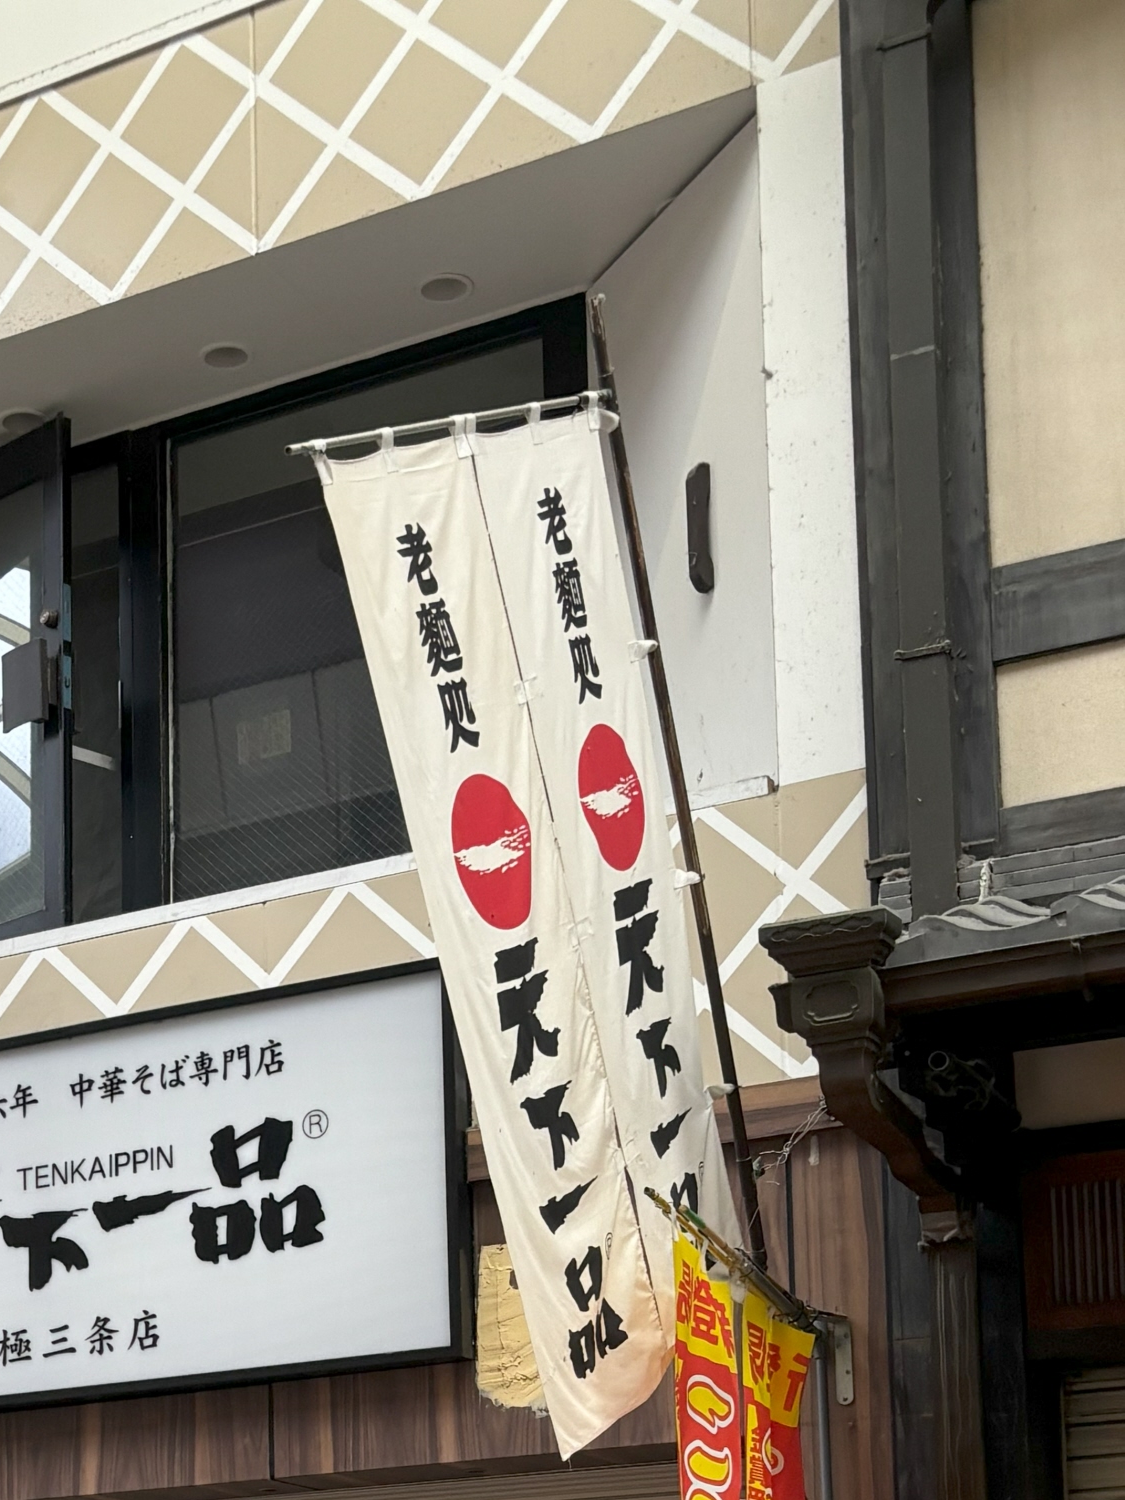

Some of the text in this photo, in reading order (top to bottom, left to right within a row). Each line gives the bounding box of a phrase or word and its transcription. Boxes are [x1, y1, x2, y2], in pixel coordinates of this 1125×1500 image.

[69, 1040, 286, 1108] 中華そば専門店
[16, 1144, 175, 1192] TENKAIPPIN
